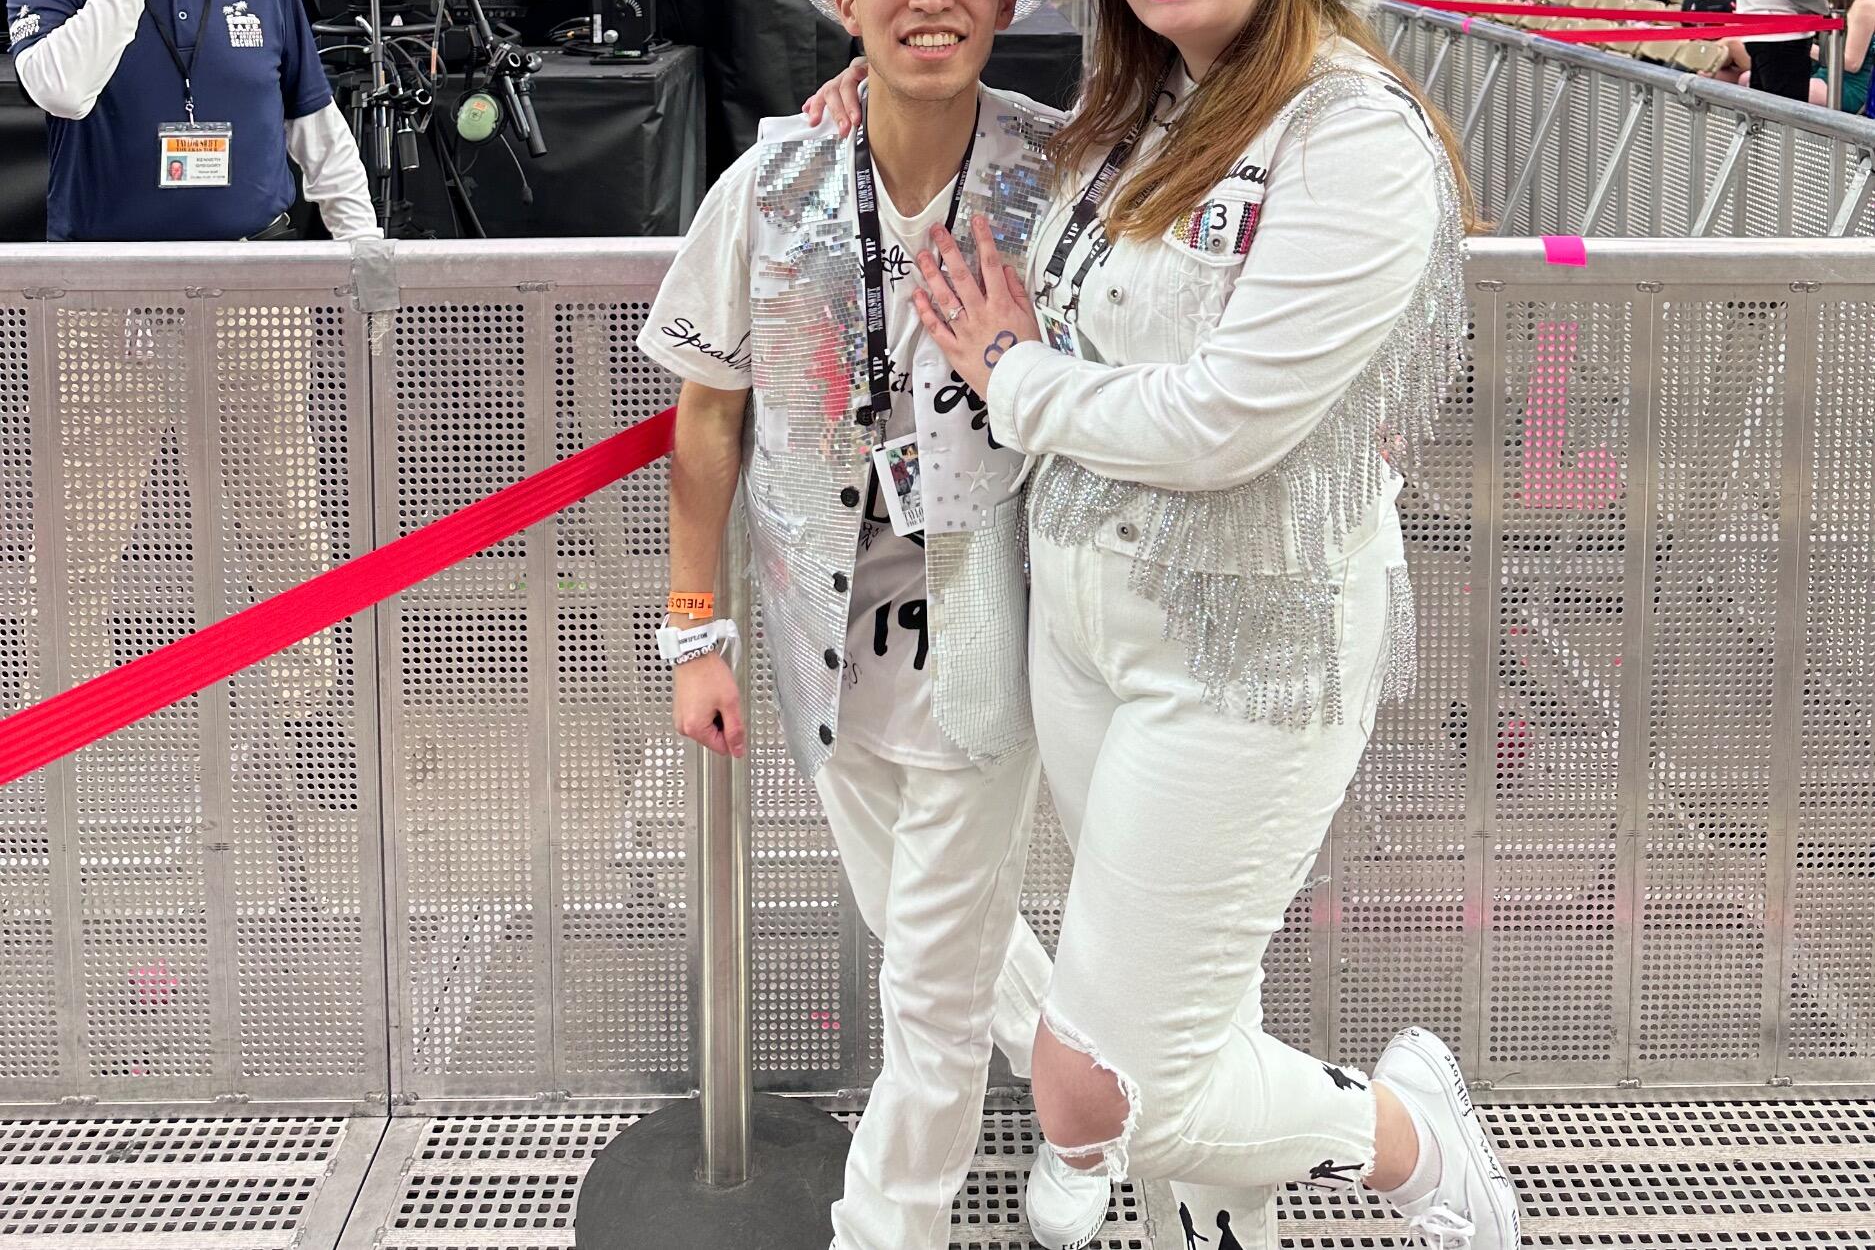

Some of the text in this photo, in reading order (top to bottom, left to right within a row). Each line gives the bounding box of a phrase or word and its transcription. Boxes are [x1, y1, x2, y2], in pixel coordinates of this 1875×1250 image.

[231, 39, 264, 48] SECURITY
[858, 190, 870, 213] TAYLOR
[1062, 223, 1080, 245] VIP
[866, 237, 877, 262] VIP
[872, 356, 883, 380] VIP
[904, 506, 924, 522] TAYLO
[675, 598, 705, 609] FIELD
[1443, 1054, 1474, 1118] folklore
